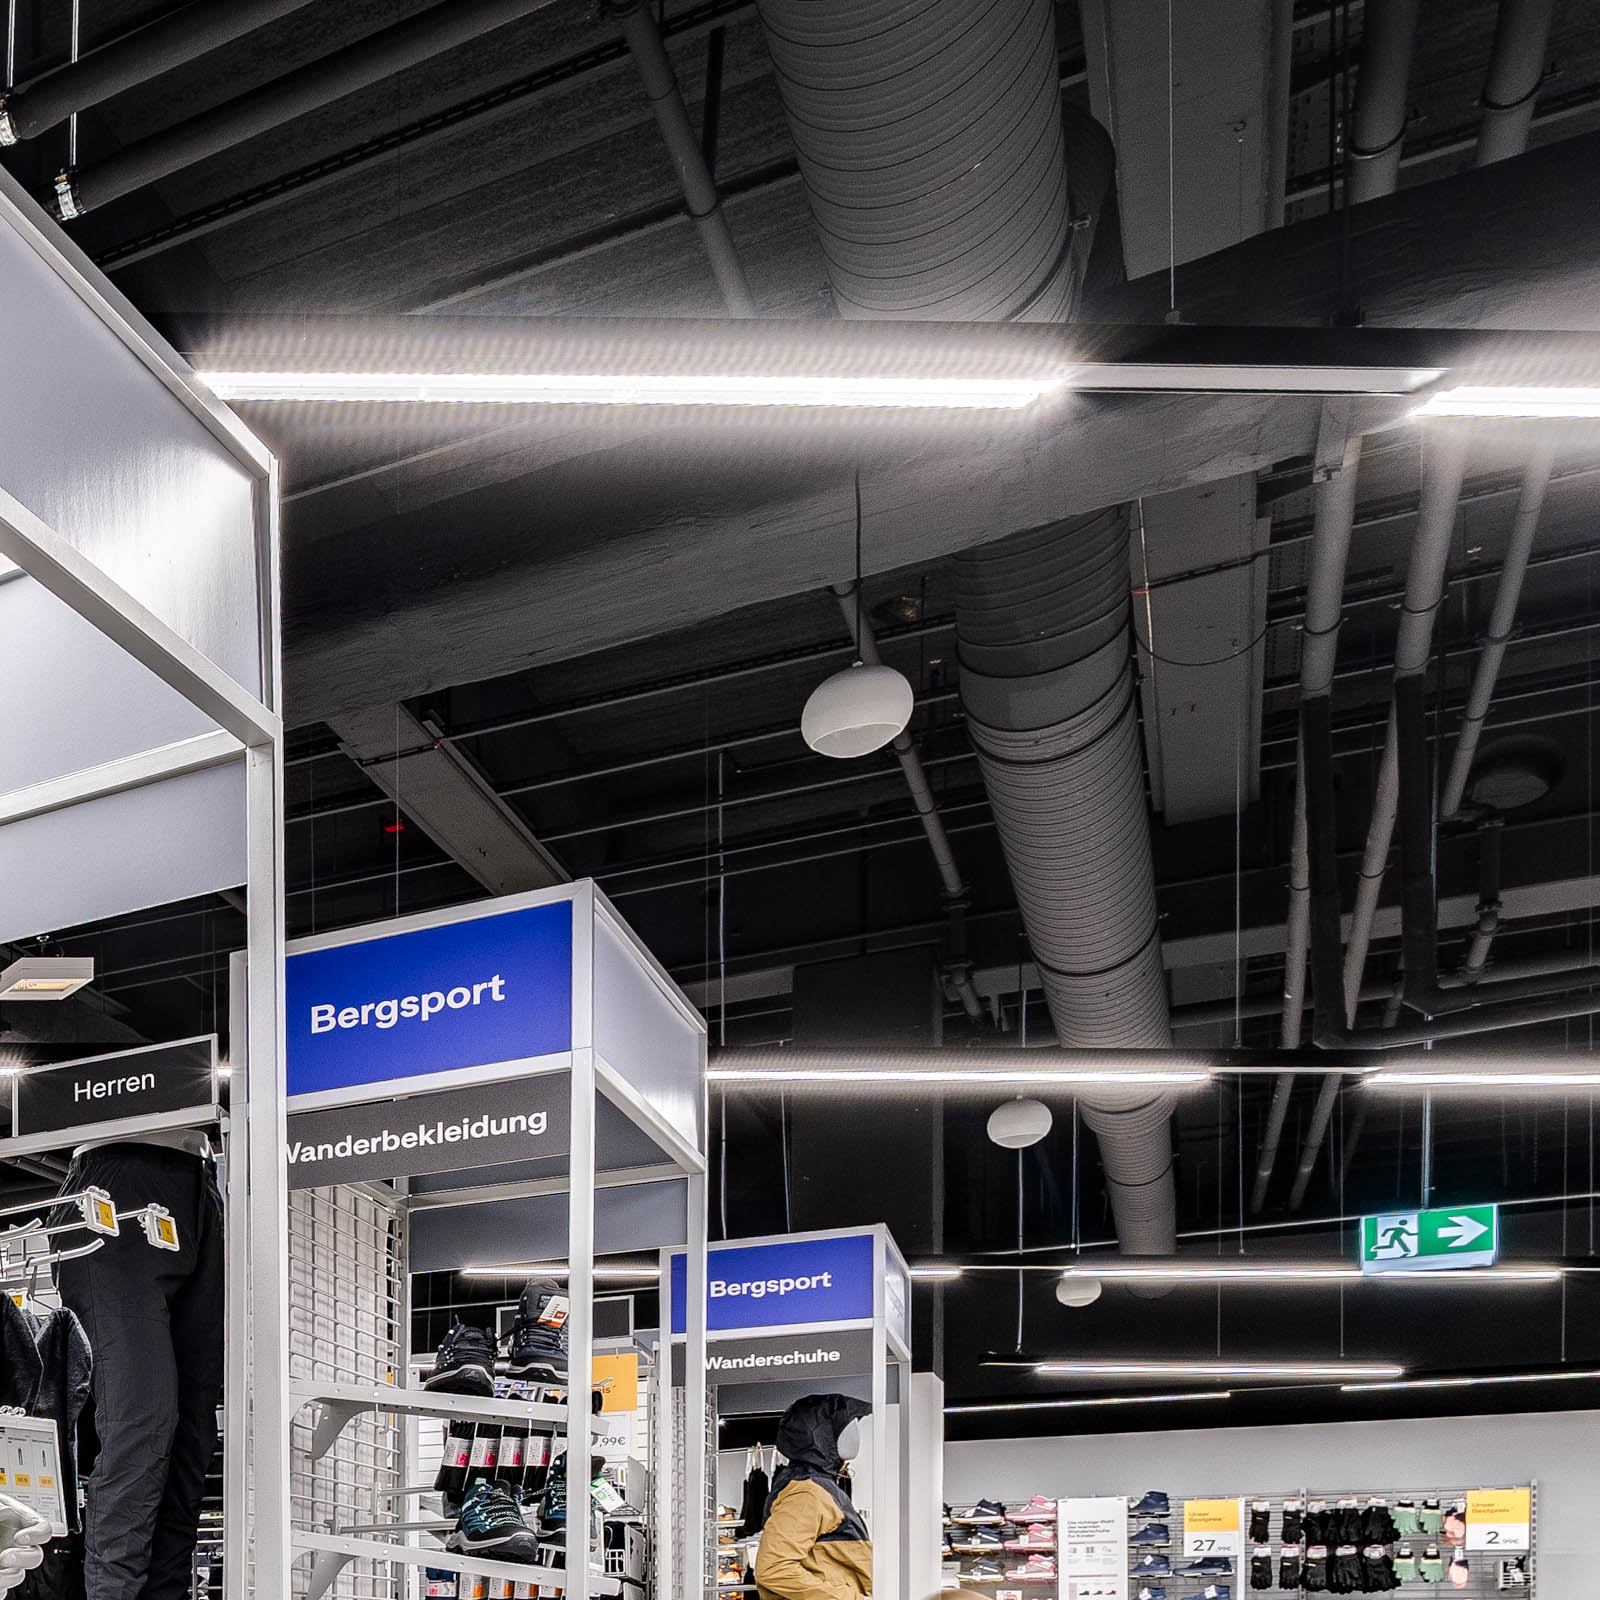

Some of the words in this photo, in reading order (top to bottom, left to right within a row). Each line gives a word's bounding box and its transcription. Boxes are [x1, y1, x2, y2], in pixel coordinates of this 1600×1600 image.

[310, 974, 506, 1035] Bergsport
[74, 1071, 155, 1102] Herren
[710, 1271, 832, 1298] Bergsport
[706, 1348, 841, 1371] Wanderschuhe
